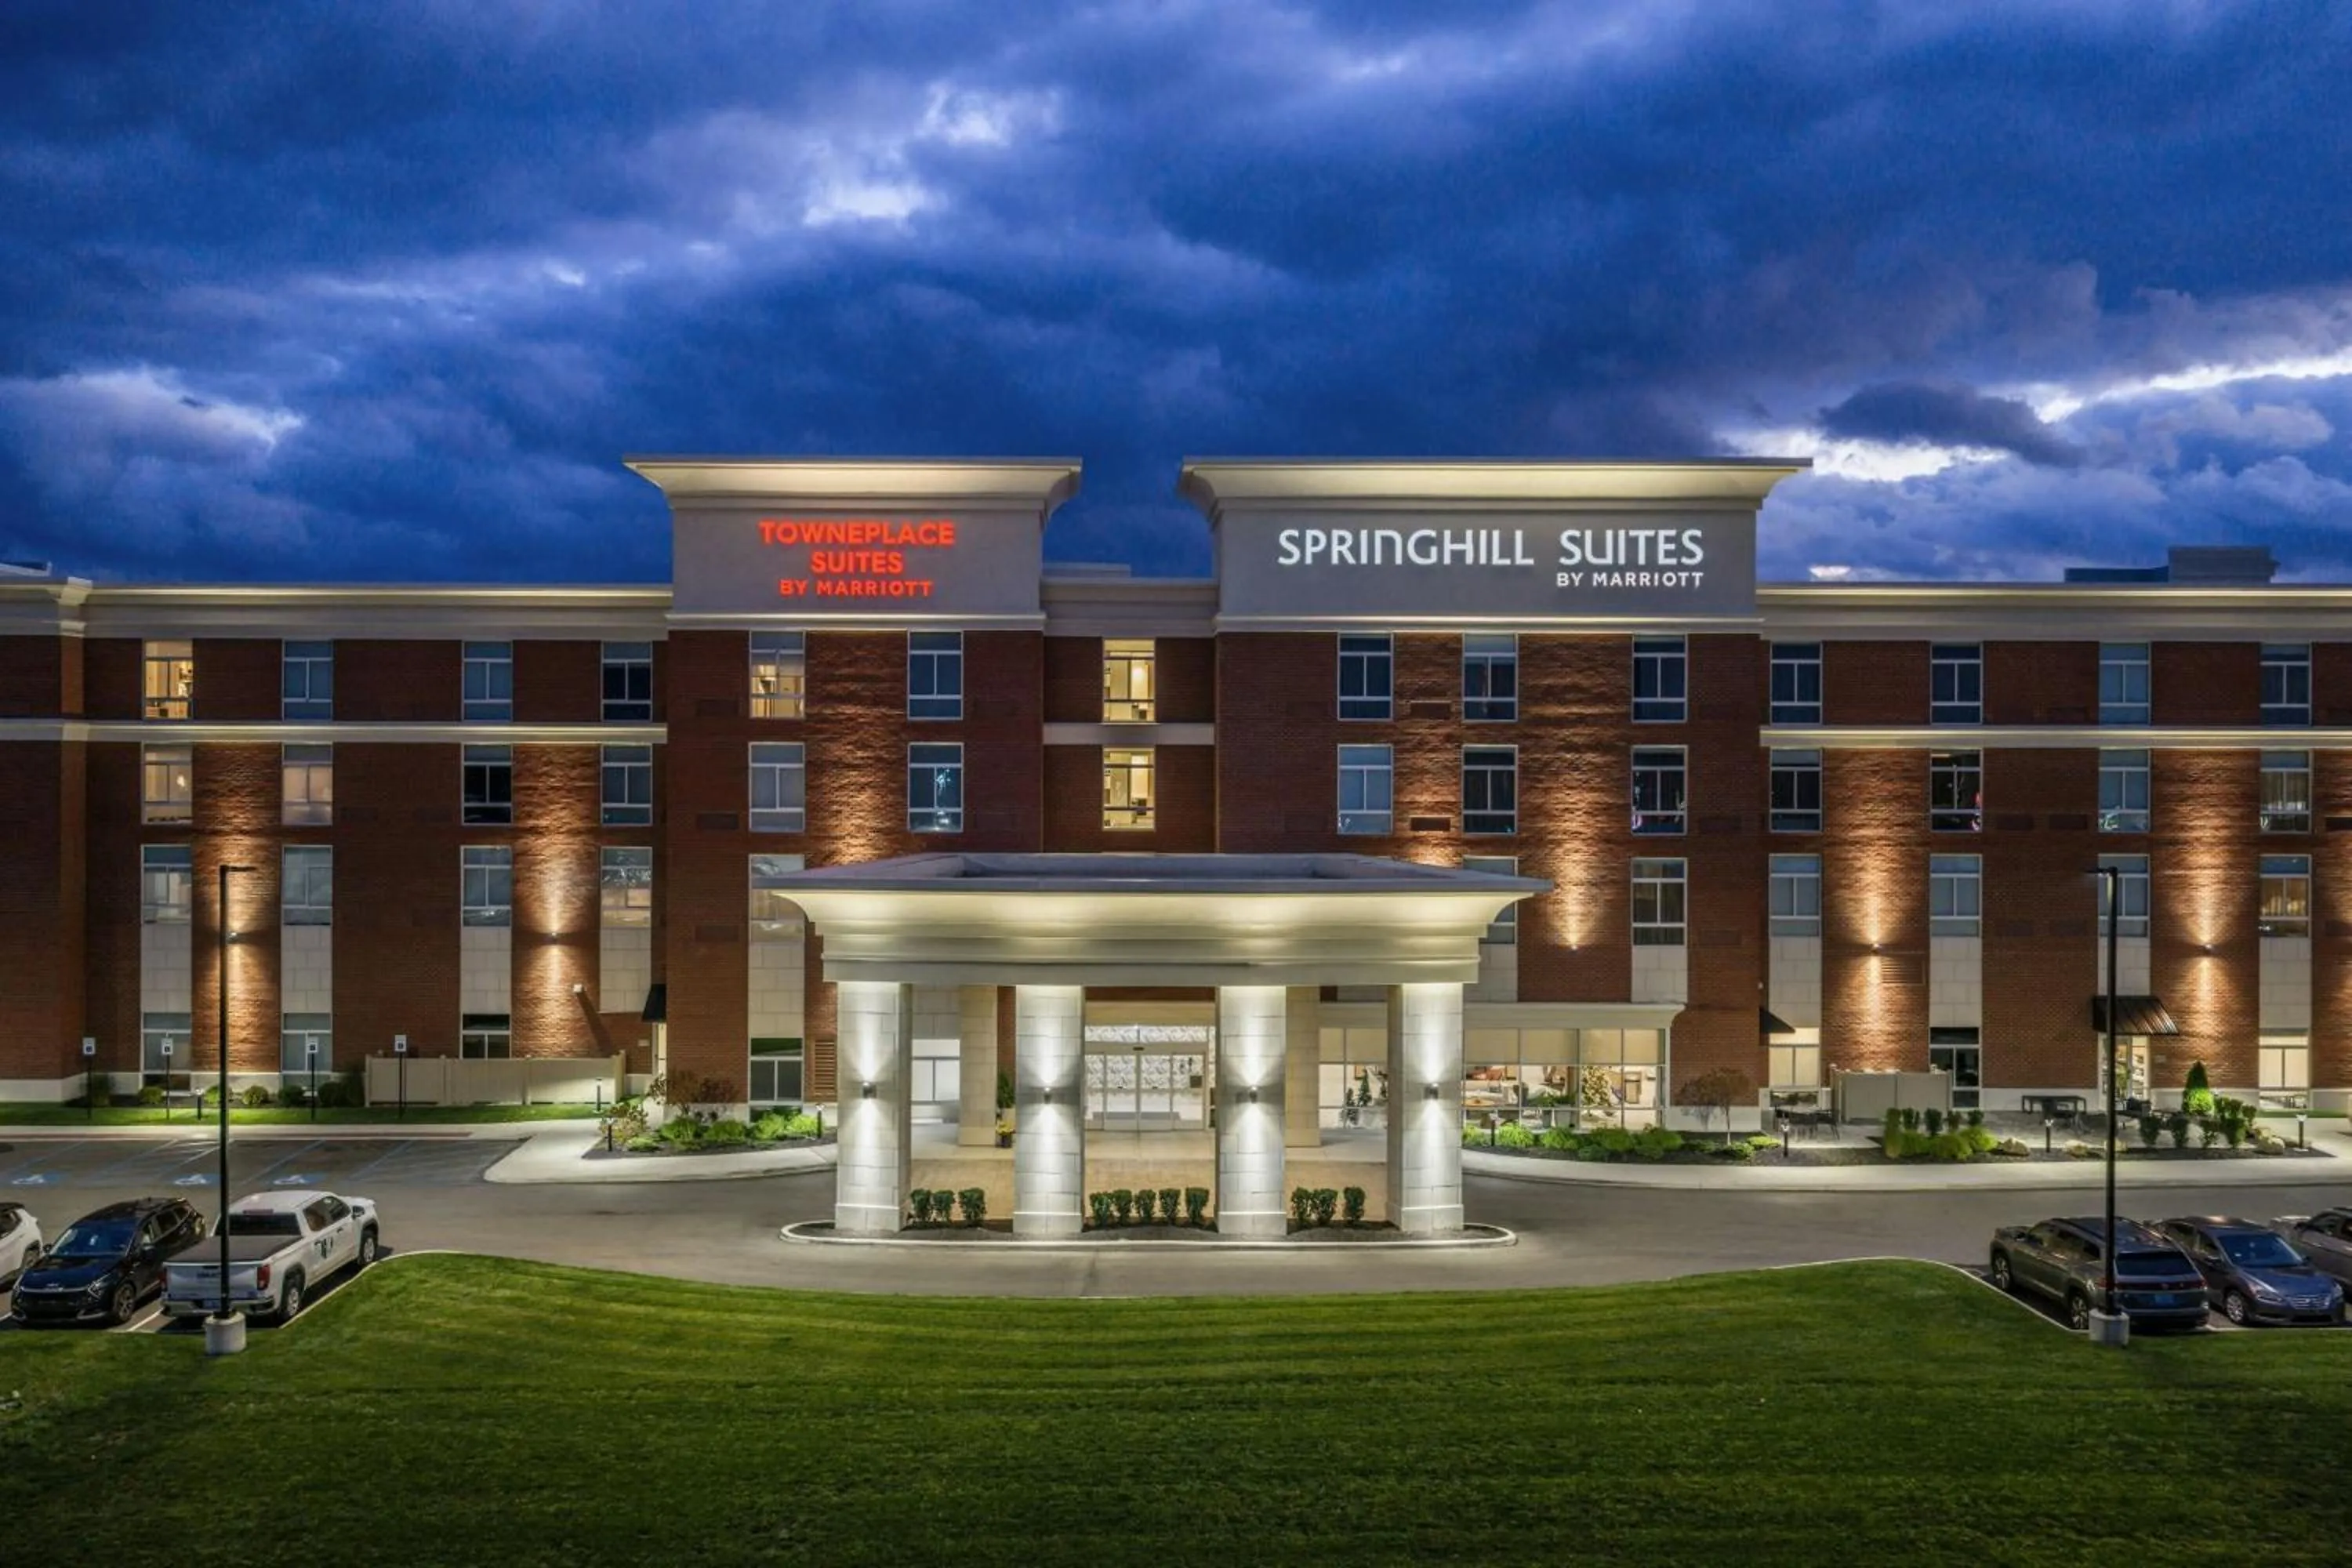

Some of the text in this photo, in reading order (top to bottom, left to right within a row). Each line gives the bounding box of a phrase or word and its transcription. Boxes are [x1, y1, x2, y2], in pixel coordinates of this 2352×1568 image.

[759, 521, 955, 545] TOWNEPLACE
[1277, 529, 1704, 565] SPRINGHILL SUITES
[811, 551, 904, 573] SUITES
[779, 580, 933, 596] BY MARRIOTT
[1556, 572, 1704, 588] BY MARRIOTT
